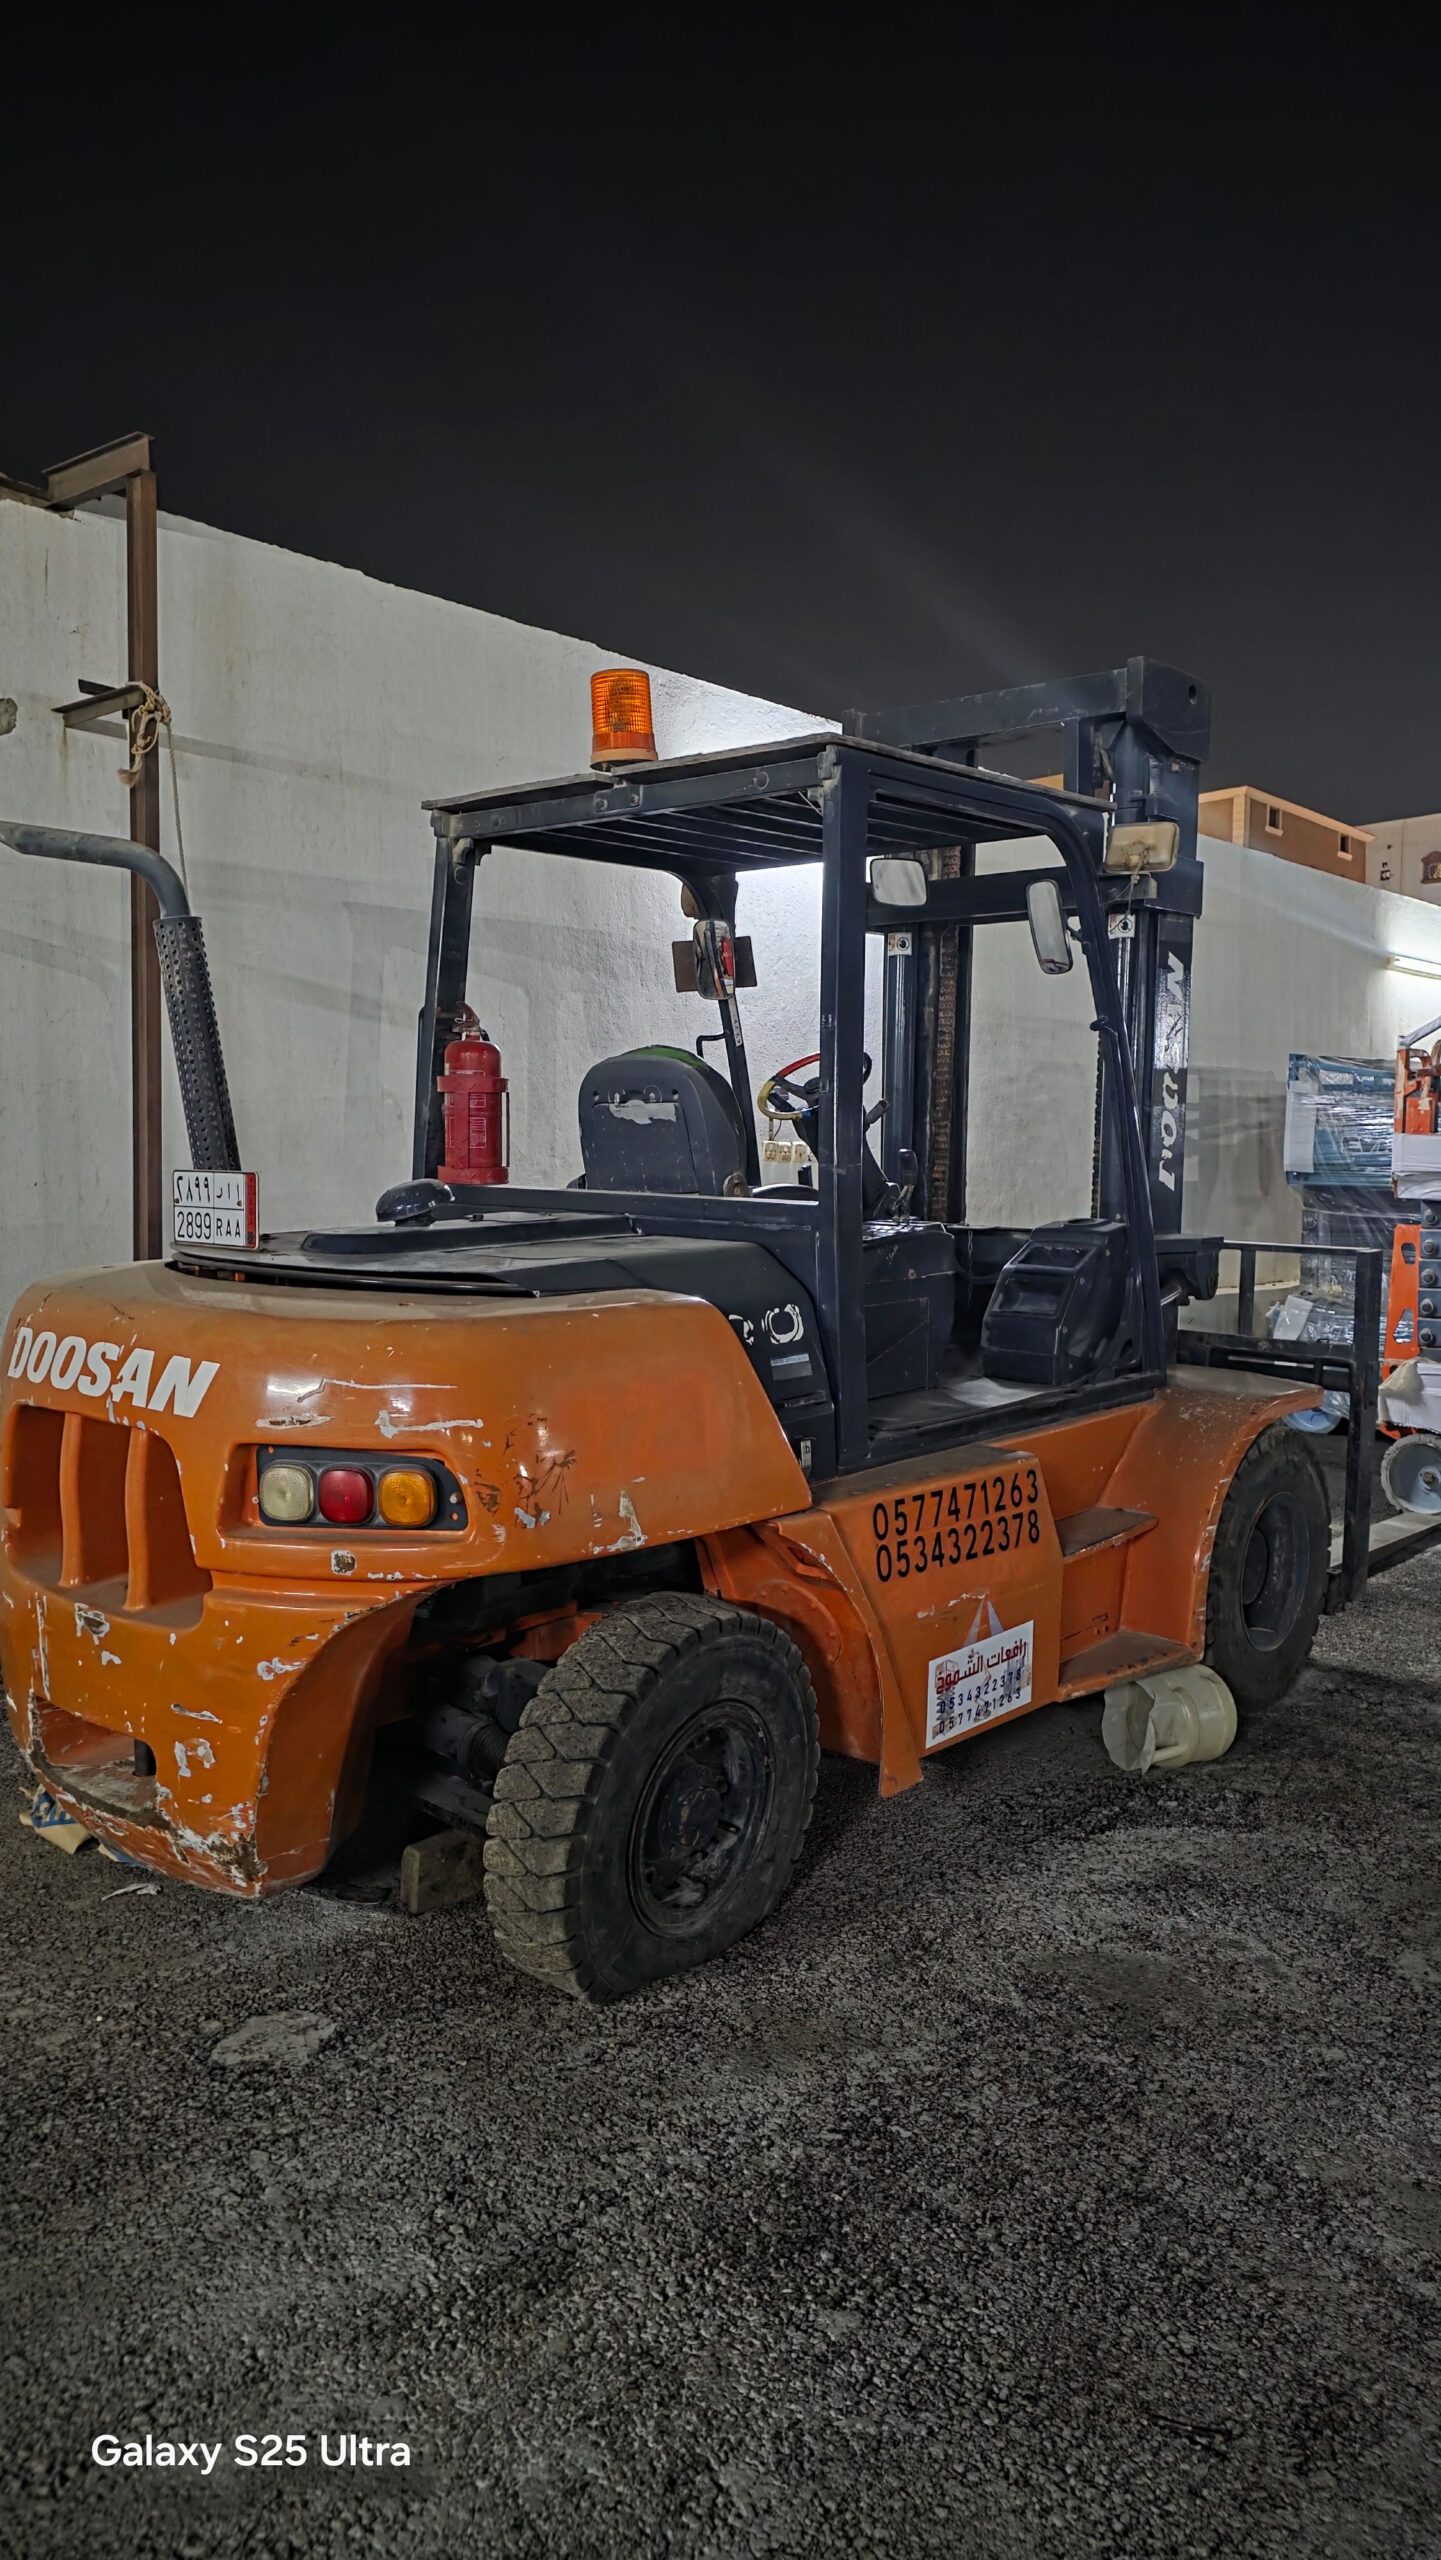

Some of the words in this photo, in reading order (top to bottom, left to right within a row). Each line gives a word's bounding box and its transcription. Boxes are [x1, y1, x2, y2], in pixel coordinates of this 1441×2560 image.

[1159, 951, 1185, 1191] DOOAN
[177, 1211, 212, 1240] 2899
[7, 1326, 221, 1419] DOOSAN
[873, 1469, 1039, 1541] 0577471263
[876, 1509, 1040, 1582] 0534322378
[936, 1654, 984, 1695] الشموخ
[986, 1638, 1027, 1669] رافعات
[940, 1668, 1021, 1714] 0534322378
[940, 1687, 1021, 1733] 0577471263
